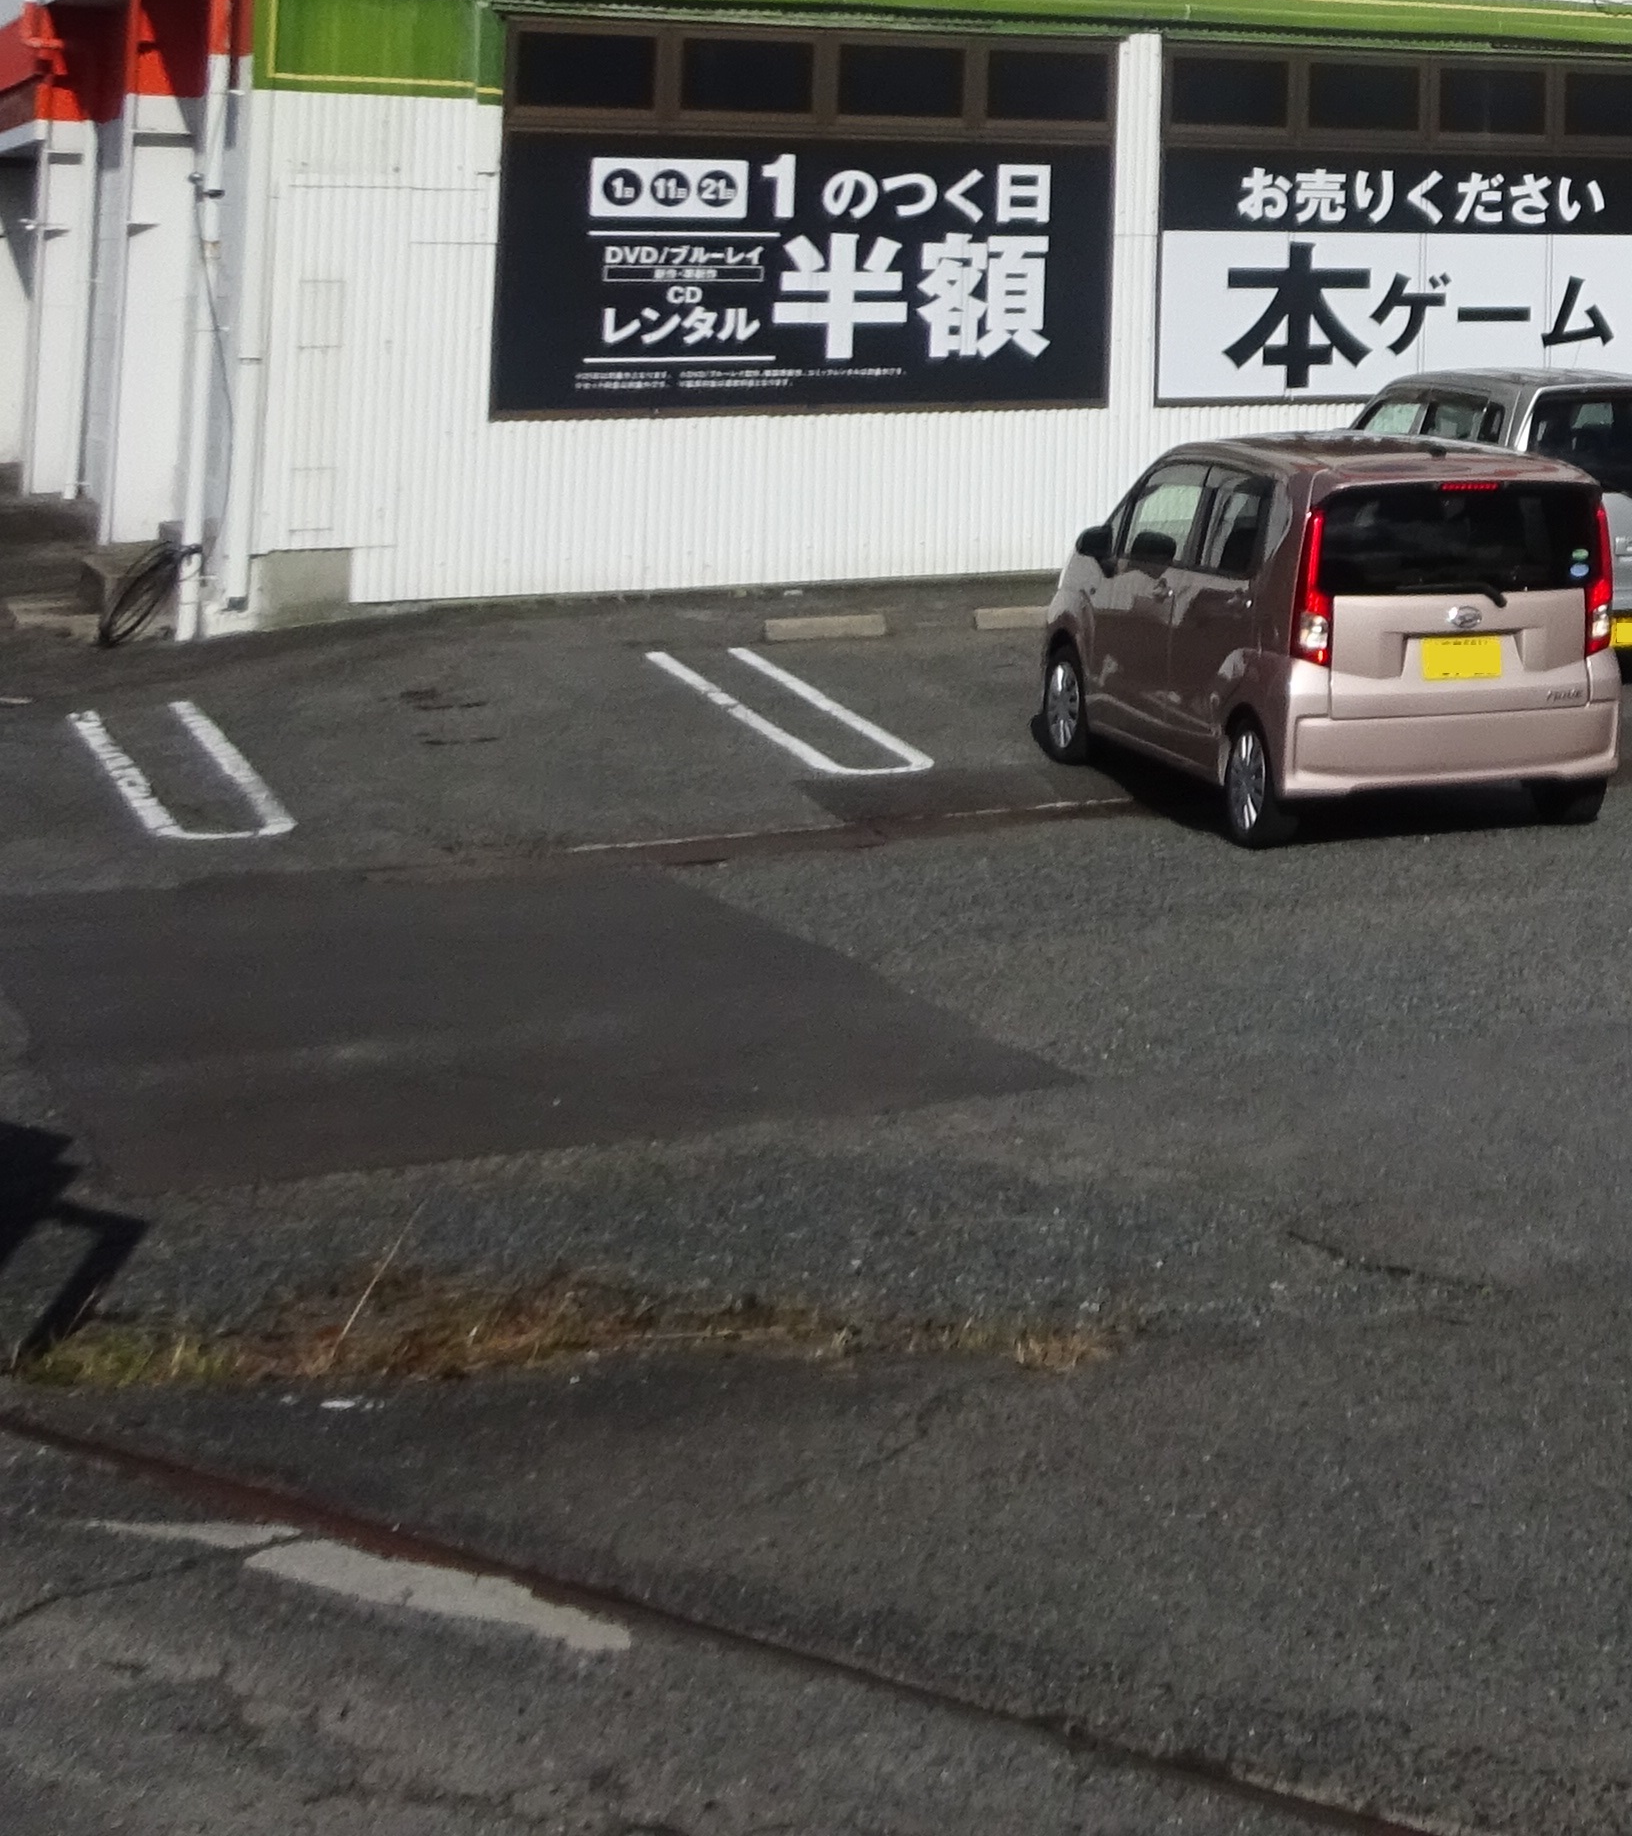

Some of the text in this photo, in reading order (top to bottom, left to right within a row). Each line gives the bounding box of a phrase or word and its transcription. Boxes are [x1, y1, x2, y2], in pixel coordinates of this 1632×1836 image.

[761, 153, 1052, 224] 1のつく日
[1237, 166, 1605, 225] お売りください
[602, 306, 762, 346] レンタル
[666, 285, 703, 305] CD
[772, 233, 1051, 360] 半額
[1222, 241, 1615, 389] 本ゲーム
